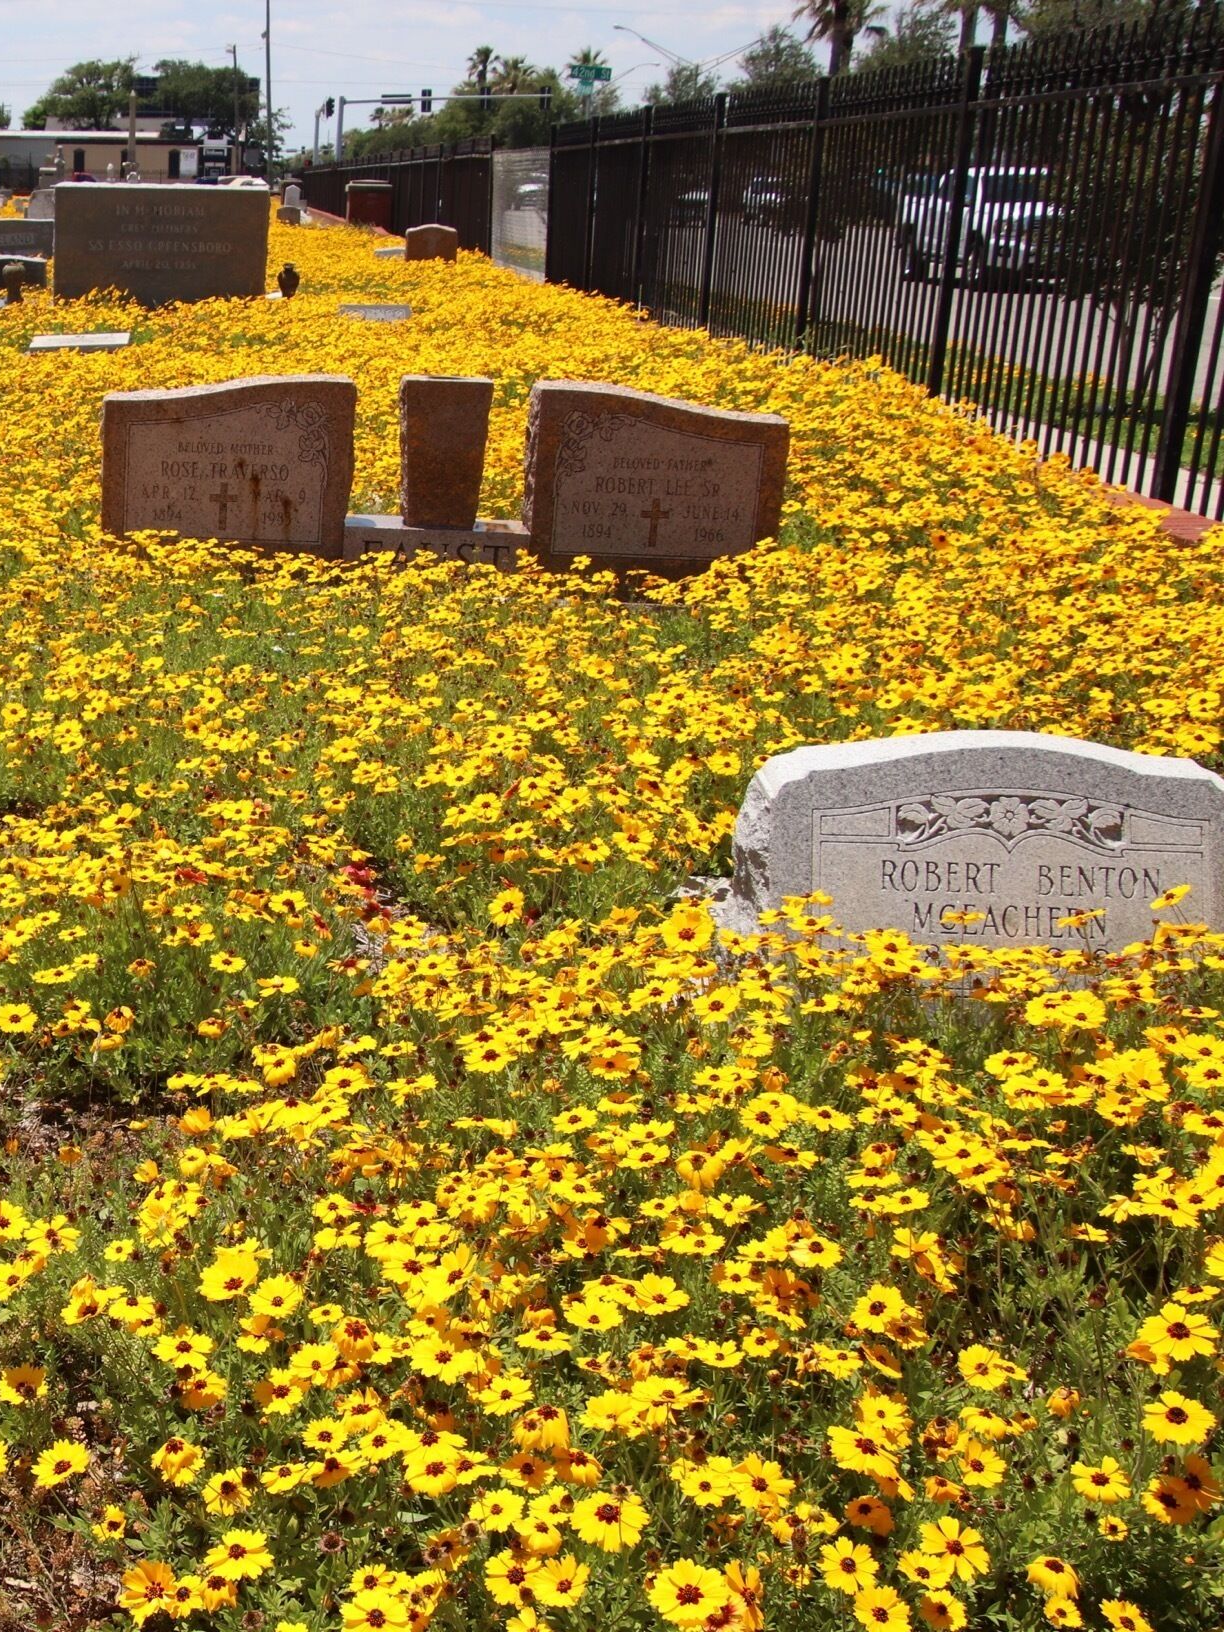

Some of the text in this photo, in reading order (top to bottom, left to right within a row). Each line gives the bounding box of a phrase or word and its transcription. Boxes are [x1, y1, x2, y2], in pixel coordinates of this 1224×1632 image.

[572, 67, 610, 79] 42nd St
[108, 240, 144, 252] ESSO
[177, 440, 274, 456] BELOVED MOTHER
[160, 460, 290, 482] ROSE TRAVERSO
[612, 456, 707, 472] BELOVED FATHER
[594, 476, 656, 496] ROBERT
[665, 479, 693, 497] LEE
[682, 504, 721, 521] JUNE
[880, 858, 1161, 901] ROBERT BENTON
